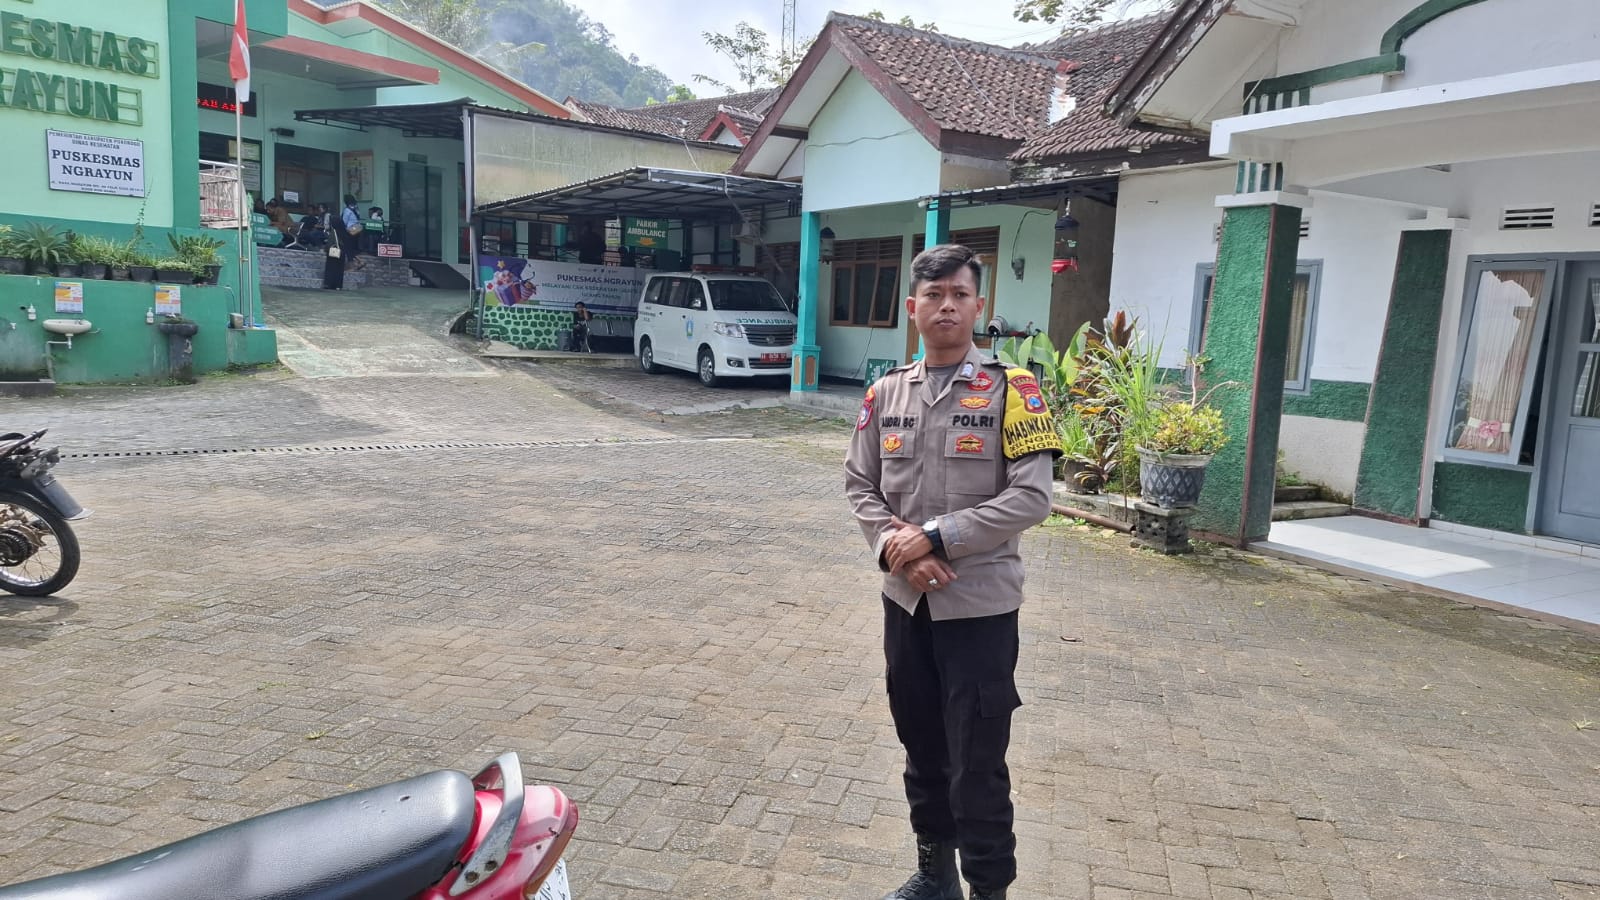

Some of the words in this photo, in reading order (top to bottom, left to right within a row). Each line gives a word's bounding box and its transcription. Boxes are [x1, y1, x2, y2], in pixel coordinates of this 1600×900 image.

[51, 149, 140, 168] PUSKESMAS
[61, 164, 133, 181] NGRAYUN
[636, 219, 658, 229] PARKIR
[627, 227, 666, 238] AMBULANCE
[557, 274, 602, 284] PUKESMAS
[952, 414, 994, 428] POLRI
